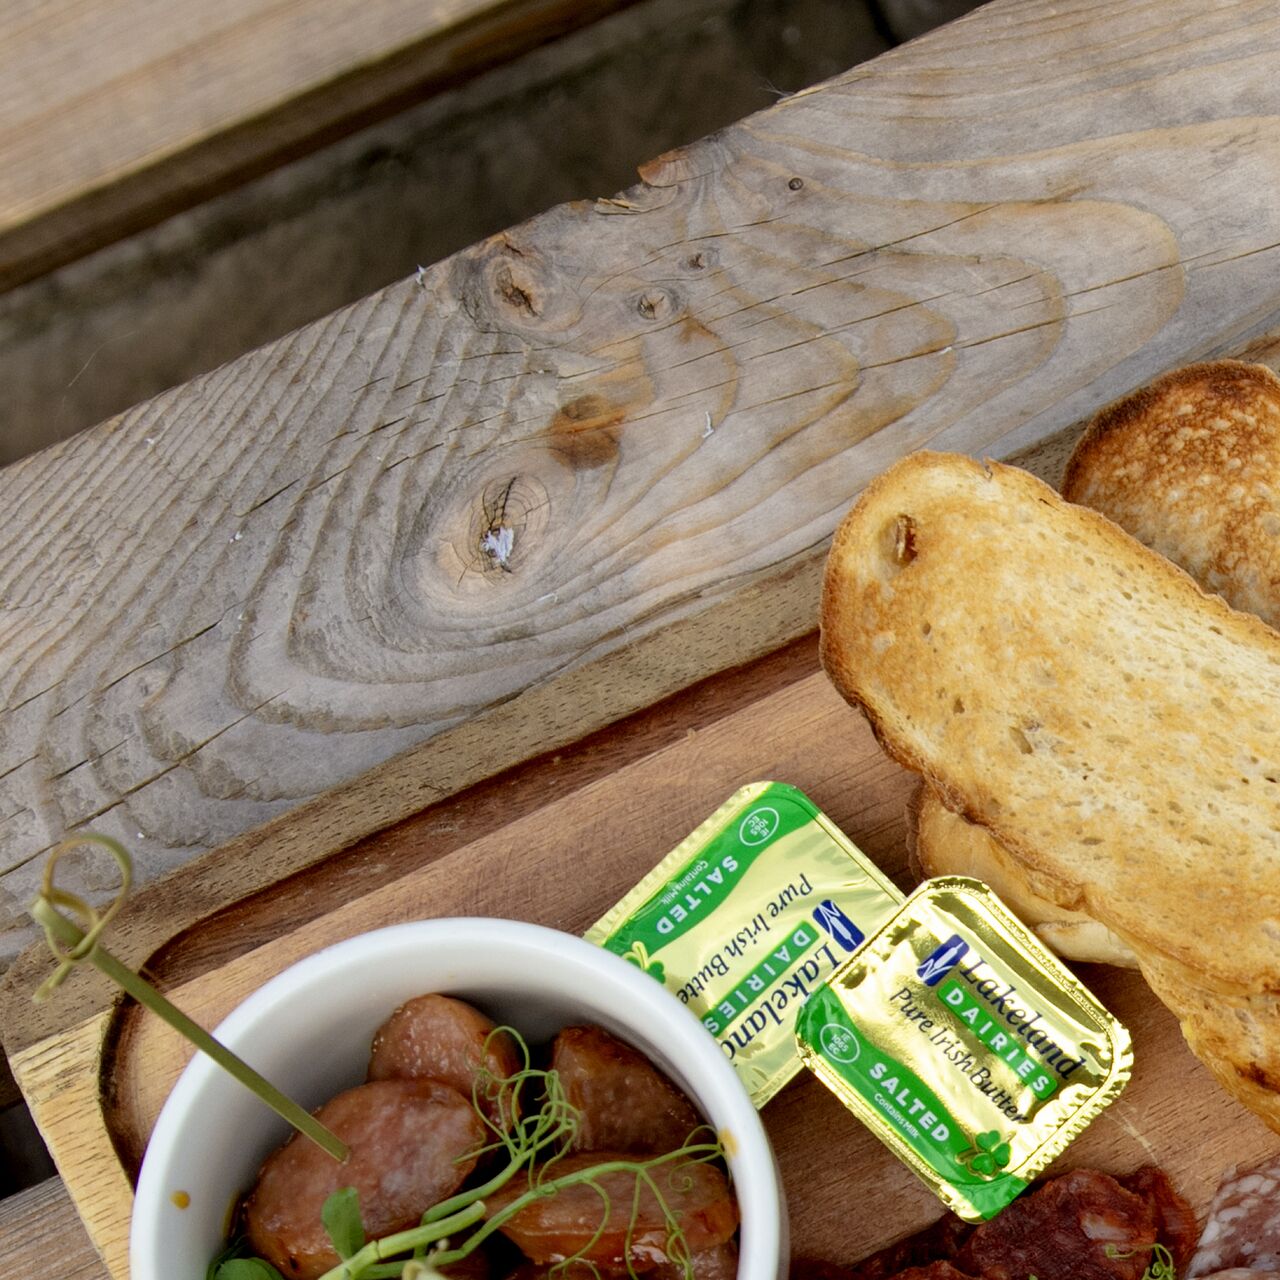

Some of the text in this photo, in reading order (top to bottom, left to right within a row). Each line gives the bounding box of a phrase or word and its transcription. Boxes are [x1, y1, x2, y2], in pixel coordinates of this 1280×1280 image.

[656, 855, 738, 934] SALTED
[661, 860, 709, 905] Contains Milk
[767, 873, 813, 917] Pure
[724, 914, 770, 957] Irish
[703, 929, 811, 1034] DAIRIES
[960, 956, 1086, 1080] Lakeland
[889, 987, 1029, 1124] Pure Irish Butter
[946, 988, 1050, 1092] DAIRIES
[869, 1062, 950, 1142] SALTED
[874, 1093, 920, 1139] Contains Milk
